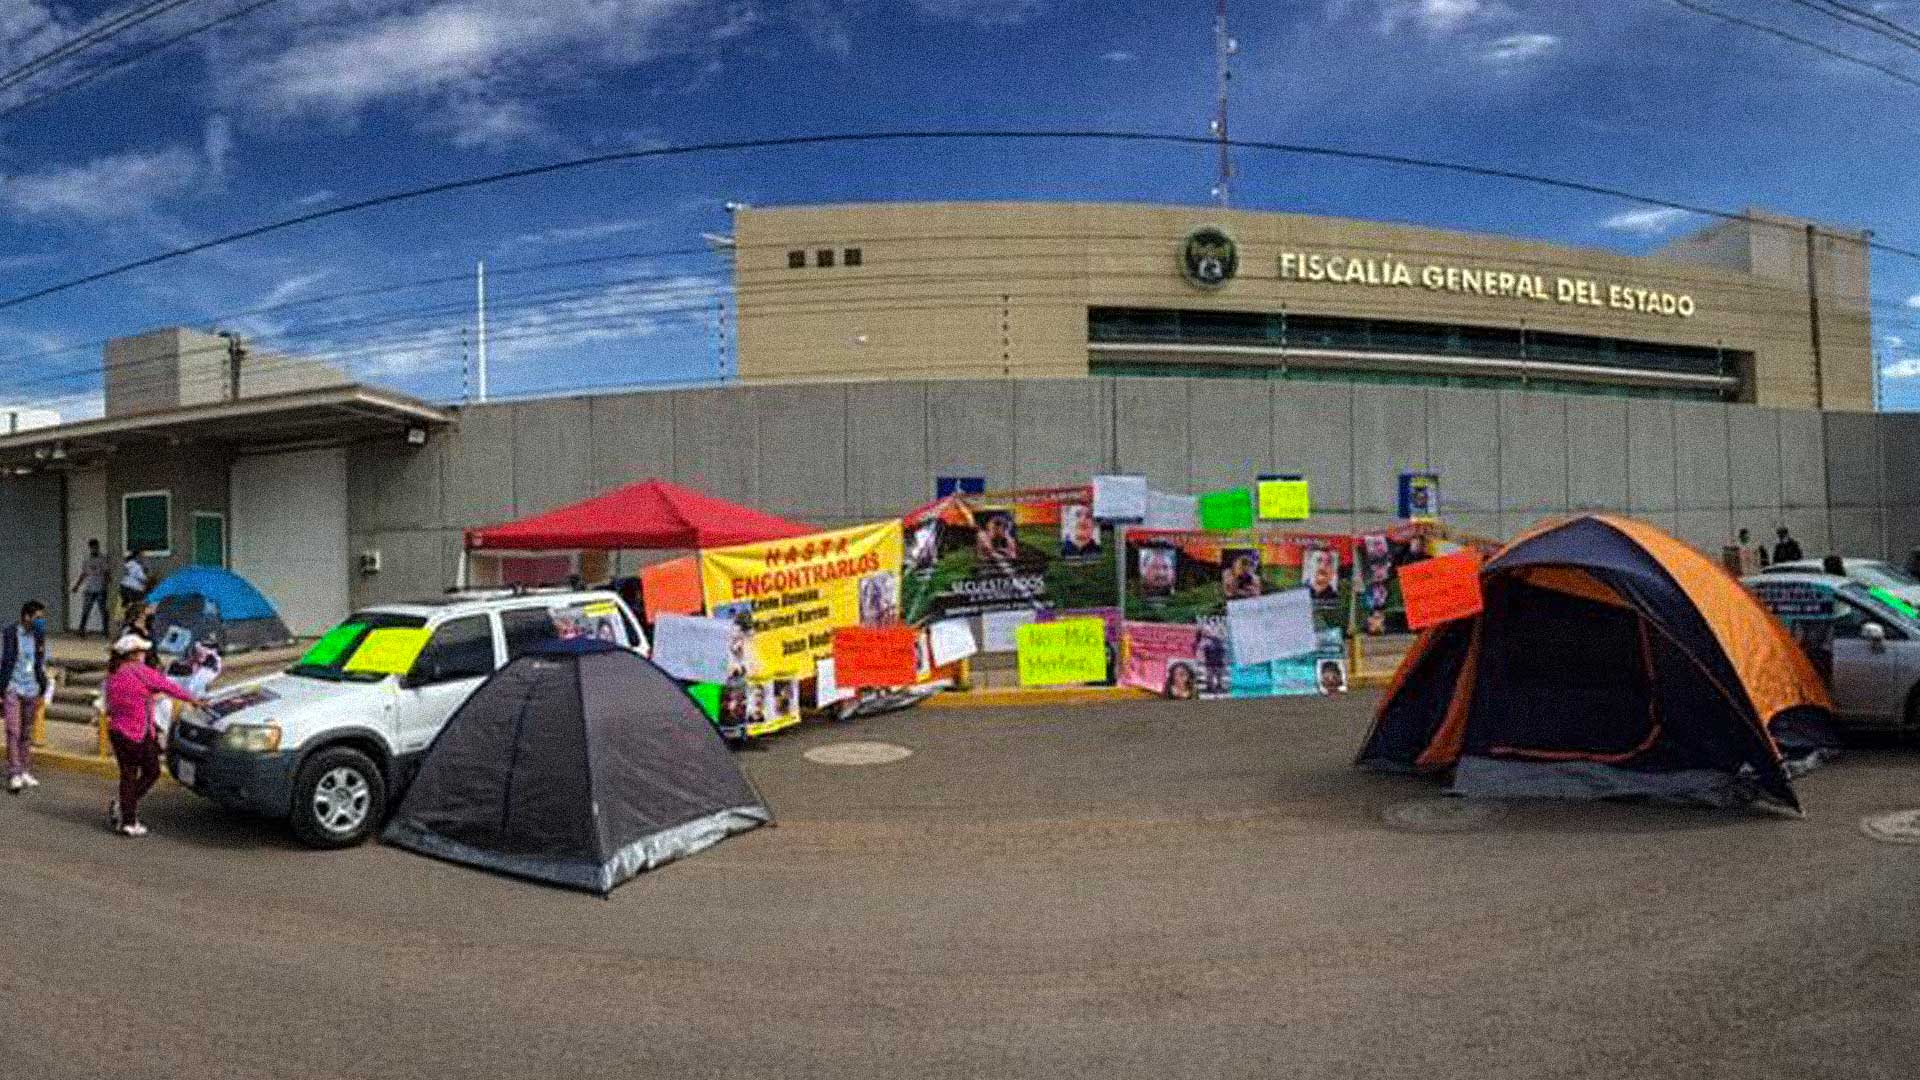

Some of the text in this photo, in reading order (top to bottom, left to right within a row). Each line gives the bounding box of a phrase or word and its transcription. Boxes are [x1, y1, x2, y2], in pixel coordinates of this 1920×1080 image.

[1281, 253, 1695, 316] FISCALÍA GENERAL DEL ESTADO
[765, 537, 848, 566] HASTA
[731, 552, 880, 600] ENCONTRARLOS
